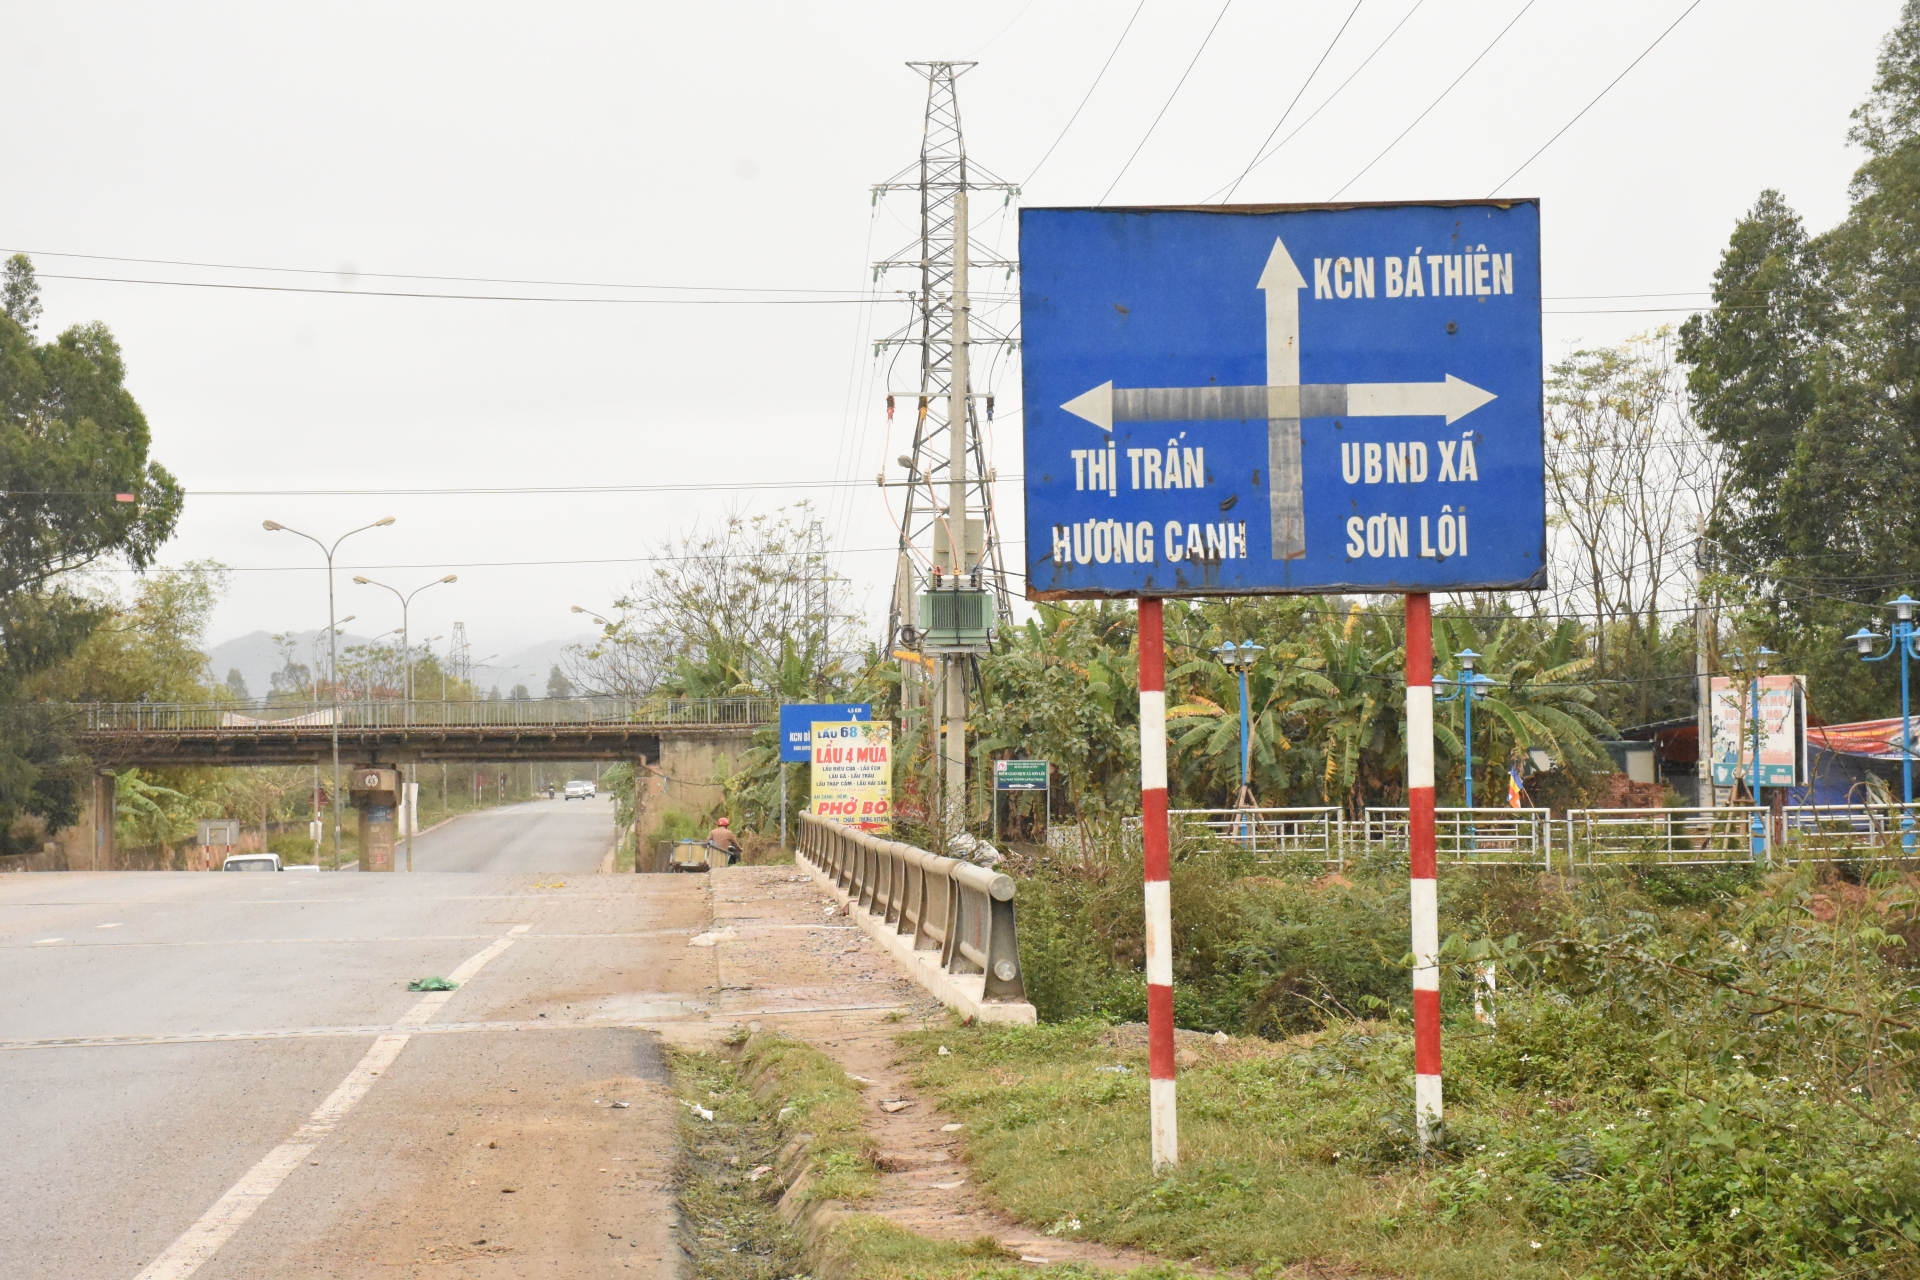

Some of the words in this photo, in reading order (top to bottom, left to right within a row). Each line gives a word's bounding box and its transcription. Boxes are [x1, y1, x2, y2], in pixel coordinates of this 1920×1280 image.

[1314, 256, 1375, 299] KCN
[1385, 247, 1425, 298] BÁ
[1071, 441, 1117, 497] THỊ
[1127, 431, 1204, 489] TRẤN
[1341, 442, 1428, 484] UBND
[1437, 430, 1478, 482] XÃ
[1053, 518, 1154, 565] HƯƠNG
[1164, 520, 1247, 562] CANH
[1346, 513, 1409, 558] SƠN
[1421, 505, 1467, 556] LÔI
[816, 740, 843, 763] LẨU
[845, 748, 853, 763] 4
[857, 743, 887, 763] MÙA
[841, 727, 858, 737] 68
[818, 797, 858, 815] PHỞ
[862, 797, 888, 815] BÒ
